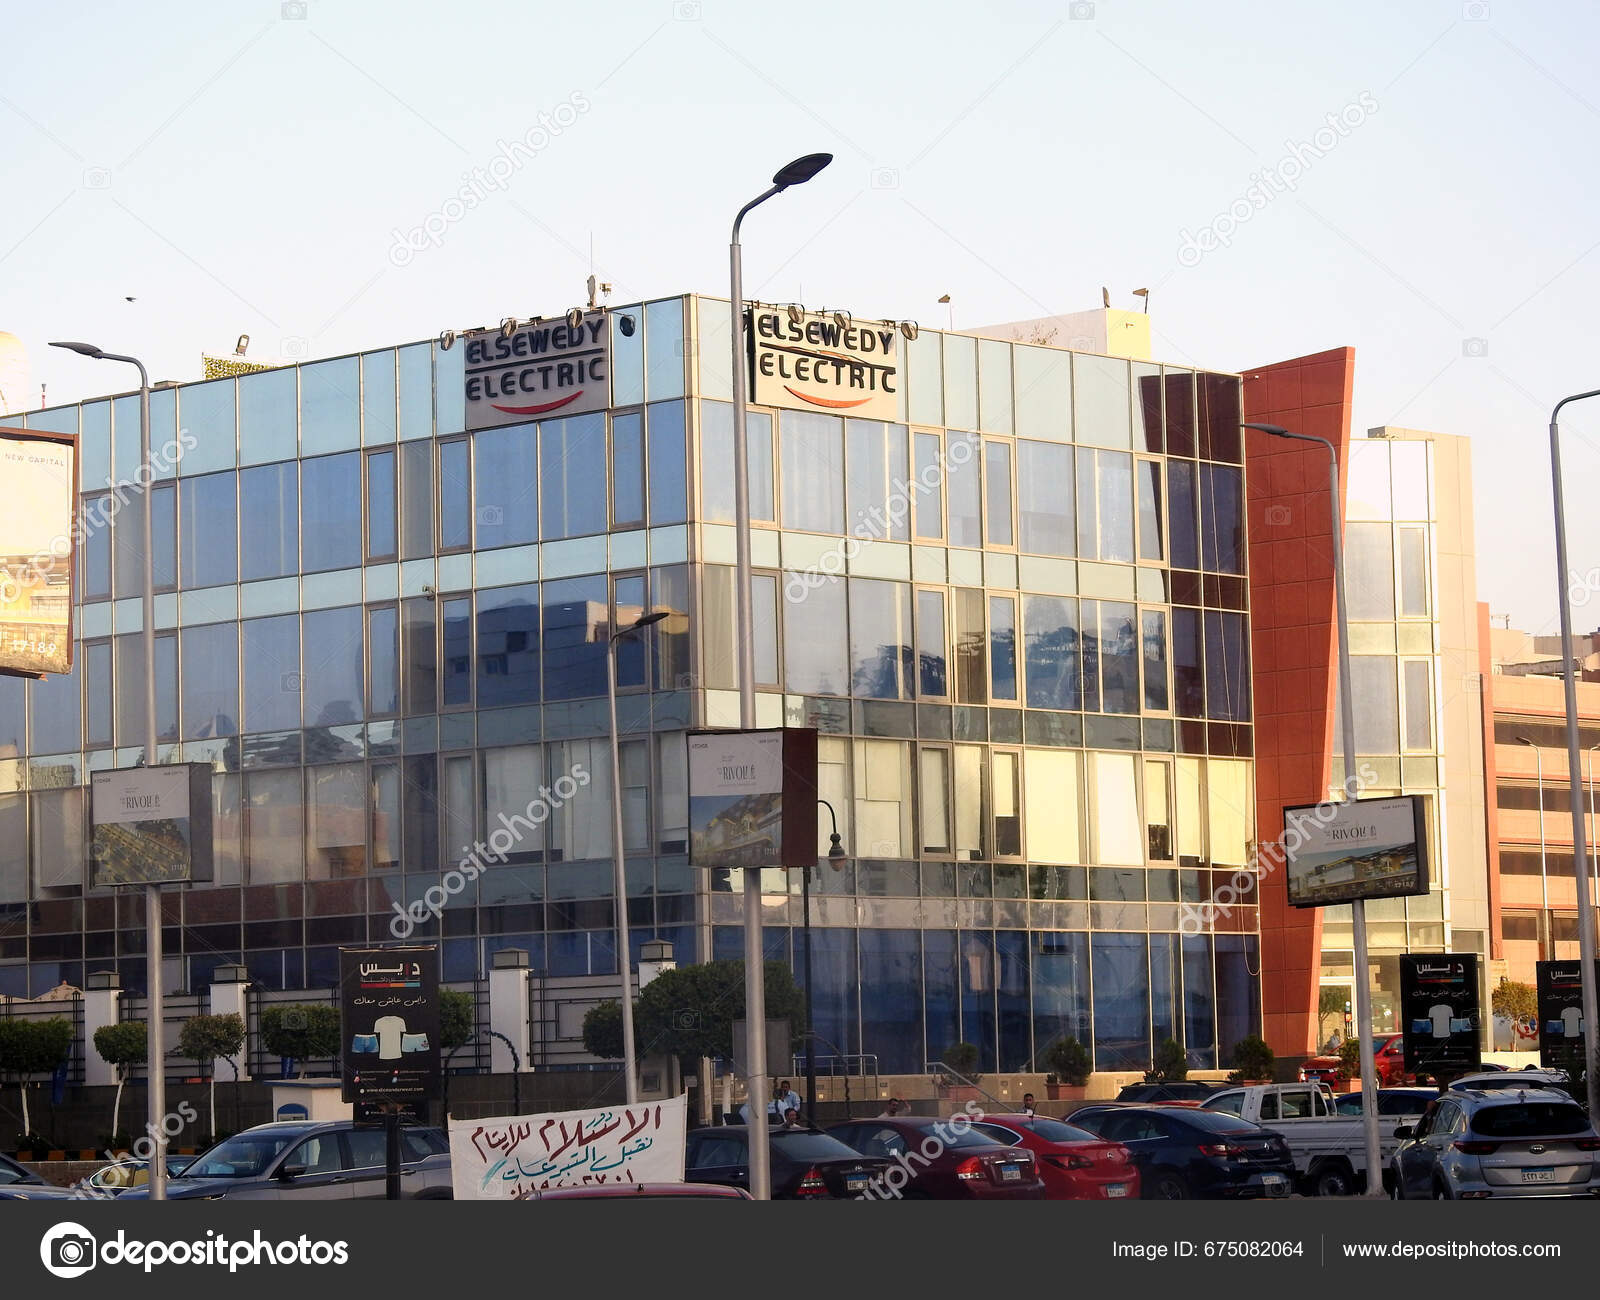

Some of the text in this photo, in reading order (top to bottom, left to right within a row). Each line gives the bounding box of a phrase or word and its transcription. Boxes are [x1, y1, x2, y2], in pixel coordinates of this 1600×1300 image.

[466, 317, 604, 363] ELSEWEDY
[757, 313, 894, 355] ELSEWEDY
[465, 357, 605, 401] ELECTRIC
[759, 352, 897, 393] ELECTRIC
[28, 456, 64, 467] CAPITAL
[590, 1136, 653, 1171] نقبل
